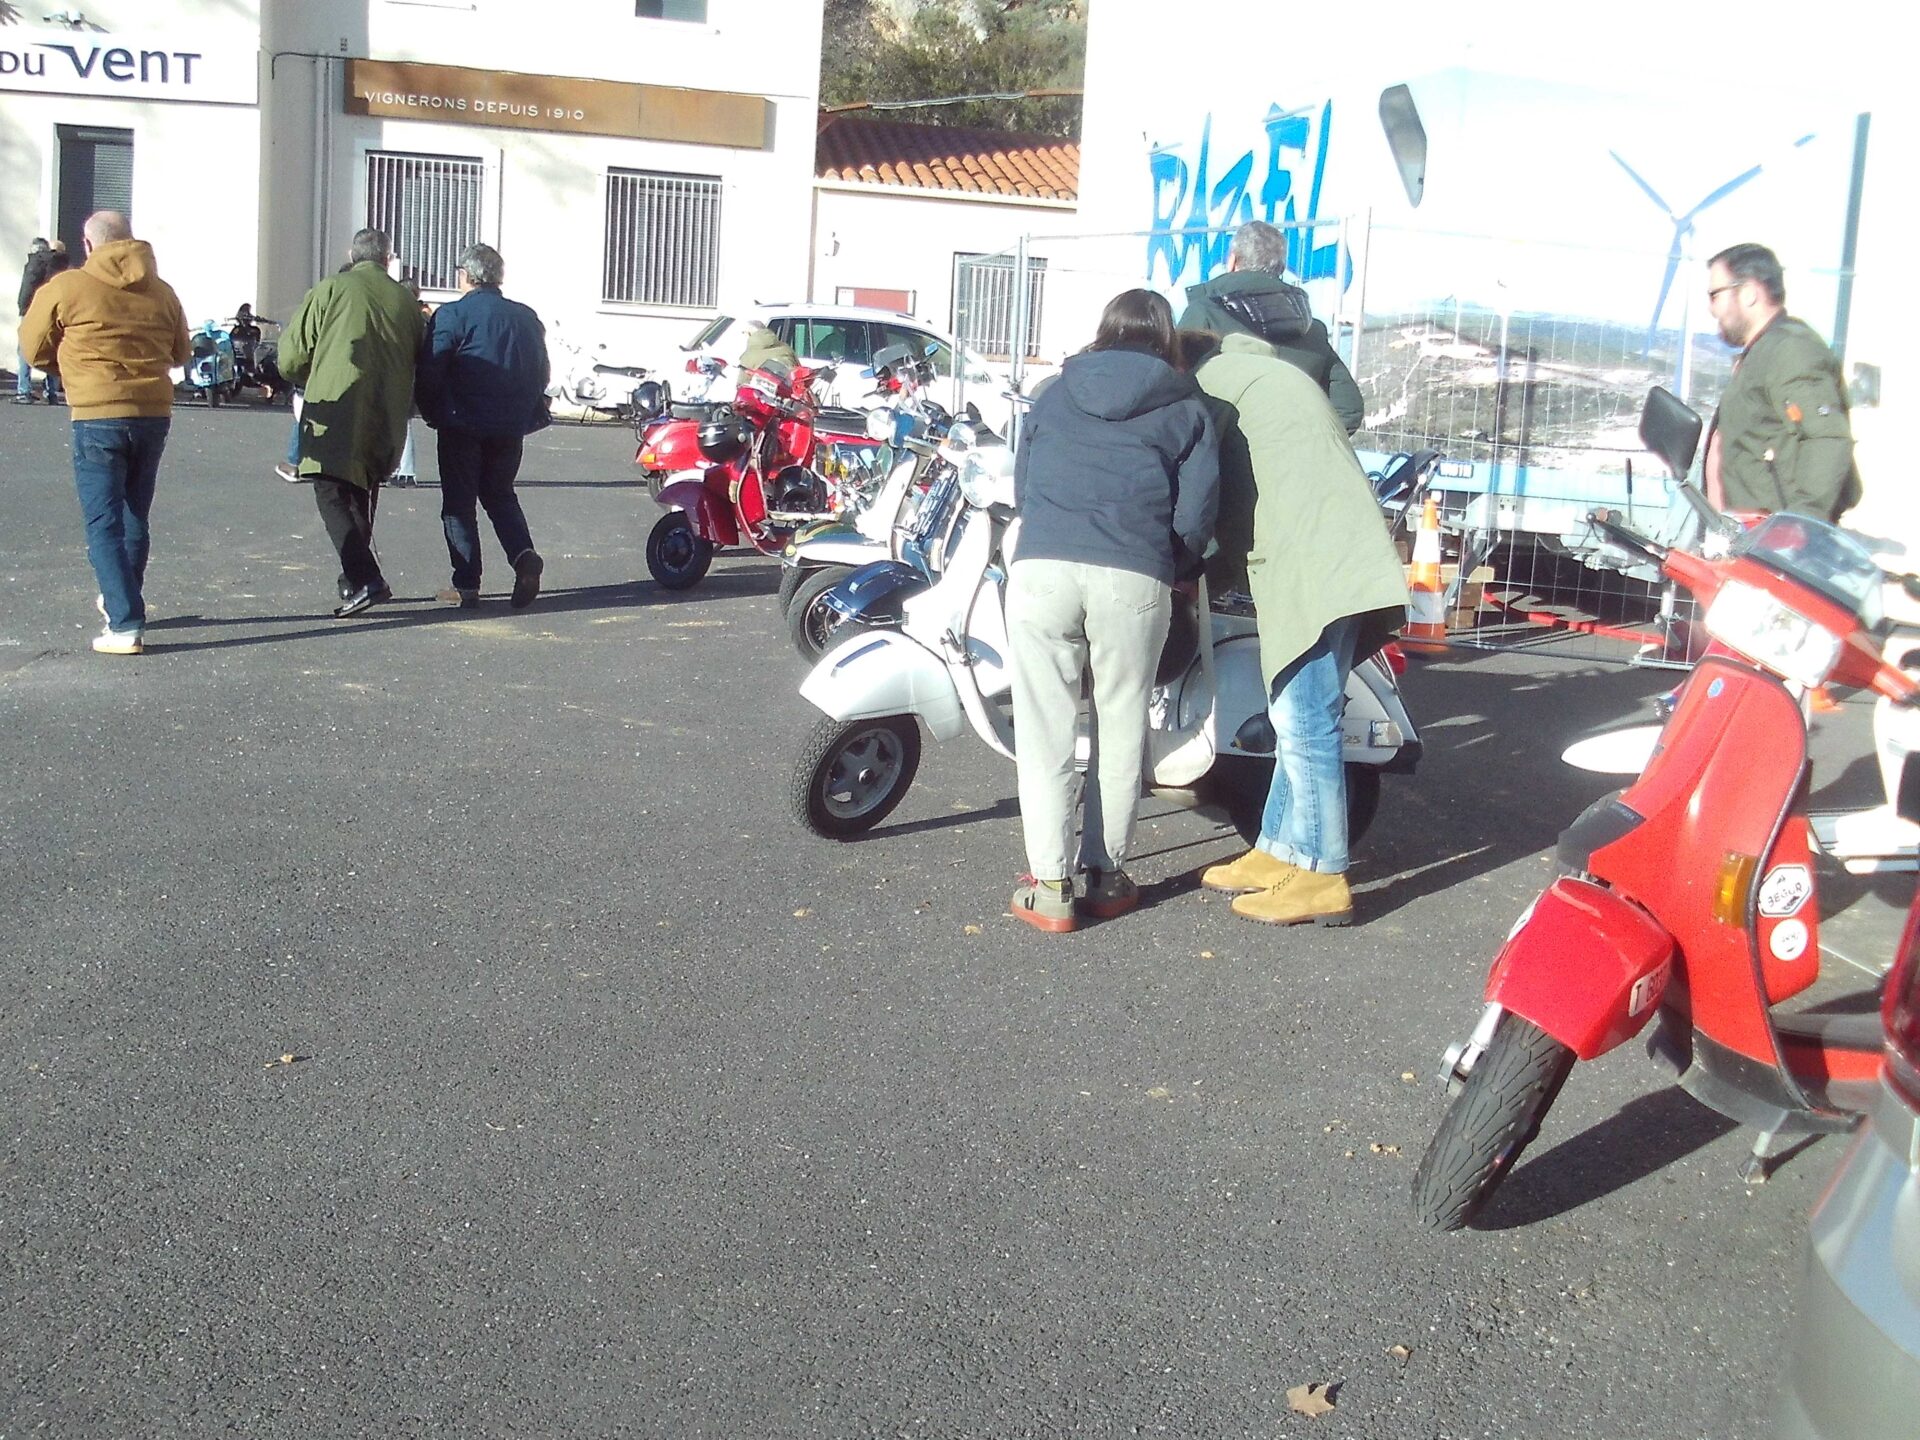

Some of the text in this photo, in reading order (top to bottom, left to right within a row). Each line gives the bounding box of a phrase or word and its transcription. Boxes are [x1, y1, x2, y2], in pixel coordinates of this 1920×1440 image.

[364, 91, 585, 121] VIGNERONS DEPUIS 1910
